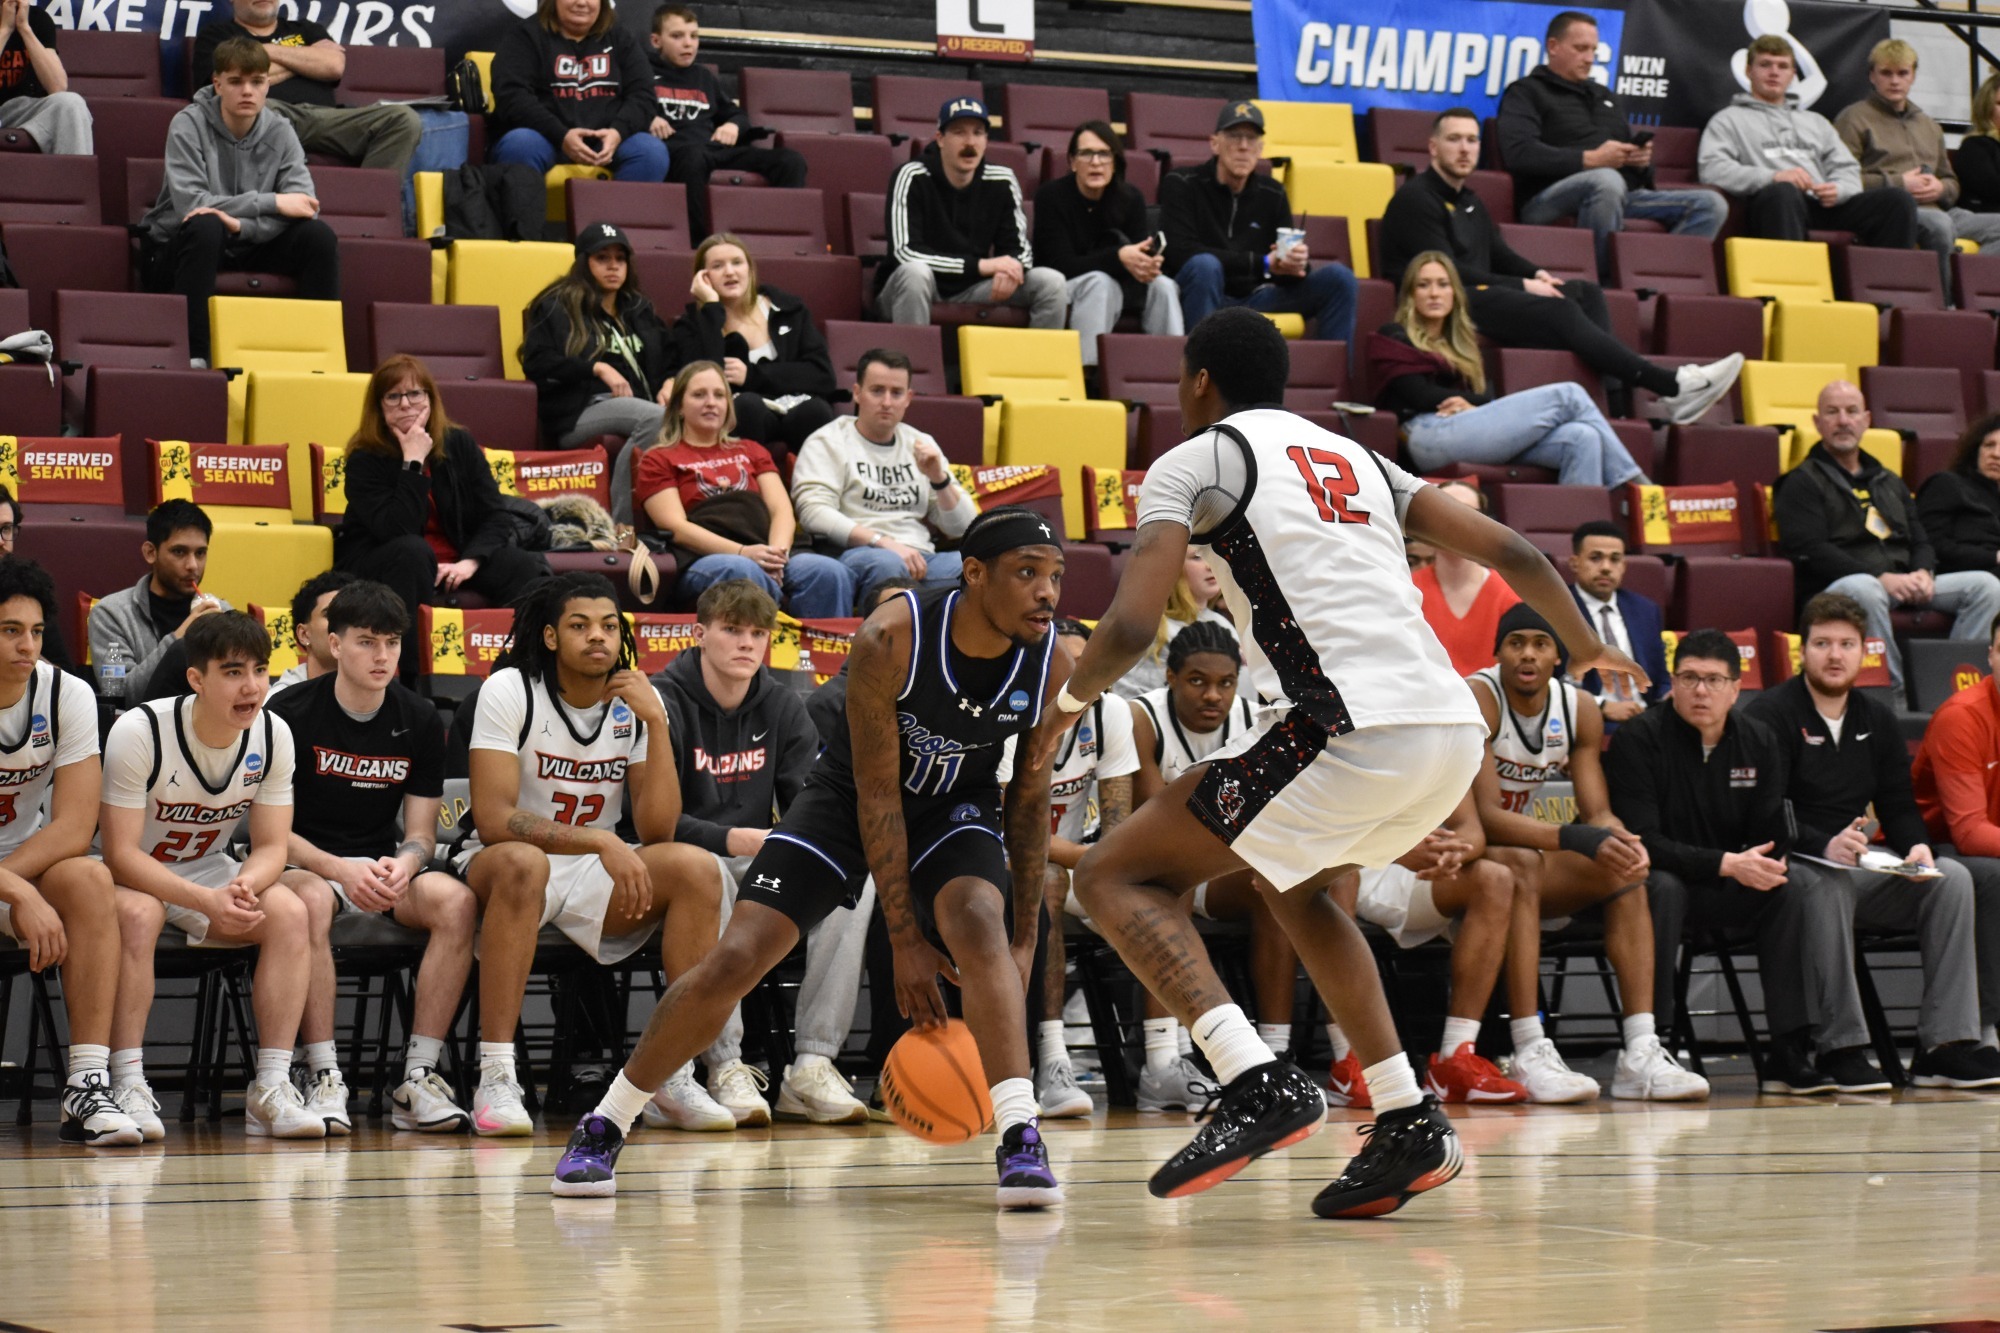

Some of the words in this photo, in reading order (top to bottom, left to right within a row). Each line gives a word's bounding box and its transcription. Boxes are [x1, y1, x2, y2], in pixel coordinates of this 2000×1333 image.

[42, 0, 147, 32] AKE
[160, 0, 213, 40] IT
[961, 38, 1025, 54] RESERVED
[1623, 55, 1665, 76] WIN
[1616, 76, 1669, 98] HERE
[601, 223, 617, 237] LA
[24, 451, 113, 467] RESERVED
[196, 455, 283, 472] RESERVED
[30, 465, 104, 481] SEATING
[203, 470, 275, 485] SEATING
[520, 461, 604, 479] RESERVED
[527, 475, 597, 492] SEATING
[1286, 445, 1371, 526] 12
[1669, 496, 1737, 512] RESERVED
[1675, 509, 1732, 523] SEATING
[997, 713, 1019, 722] CIAA
[315, 747, 411, 783] VULCANS
[538, 754, 628, 782] VULCANS
[904, 750, 966, 797] 11
[157, 800, 252, 825] VULCANS
[552, 791, 605, 827] 32
[150, 829, 221, 863] 23
